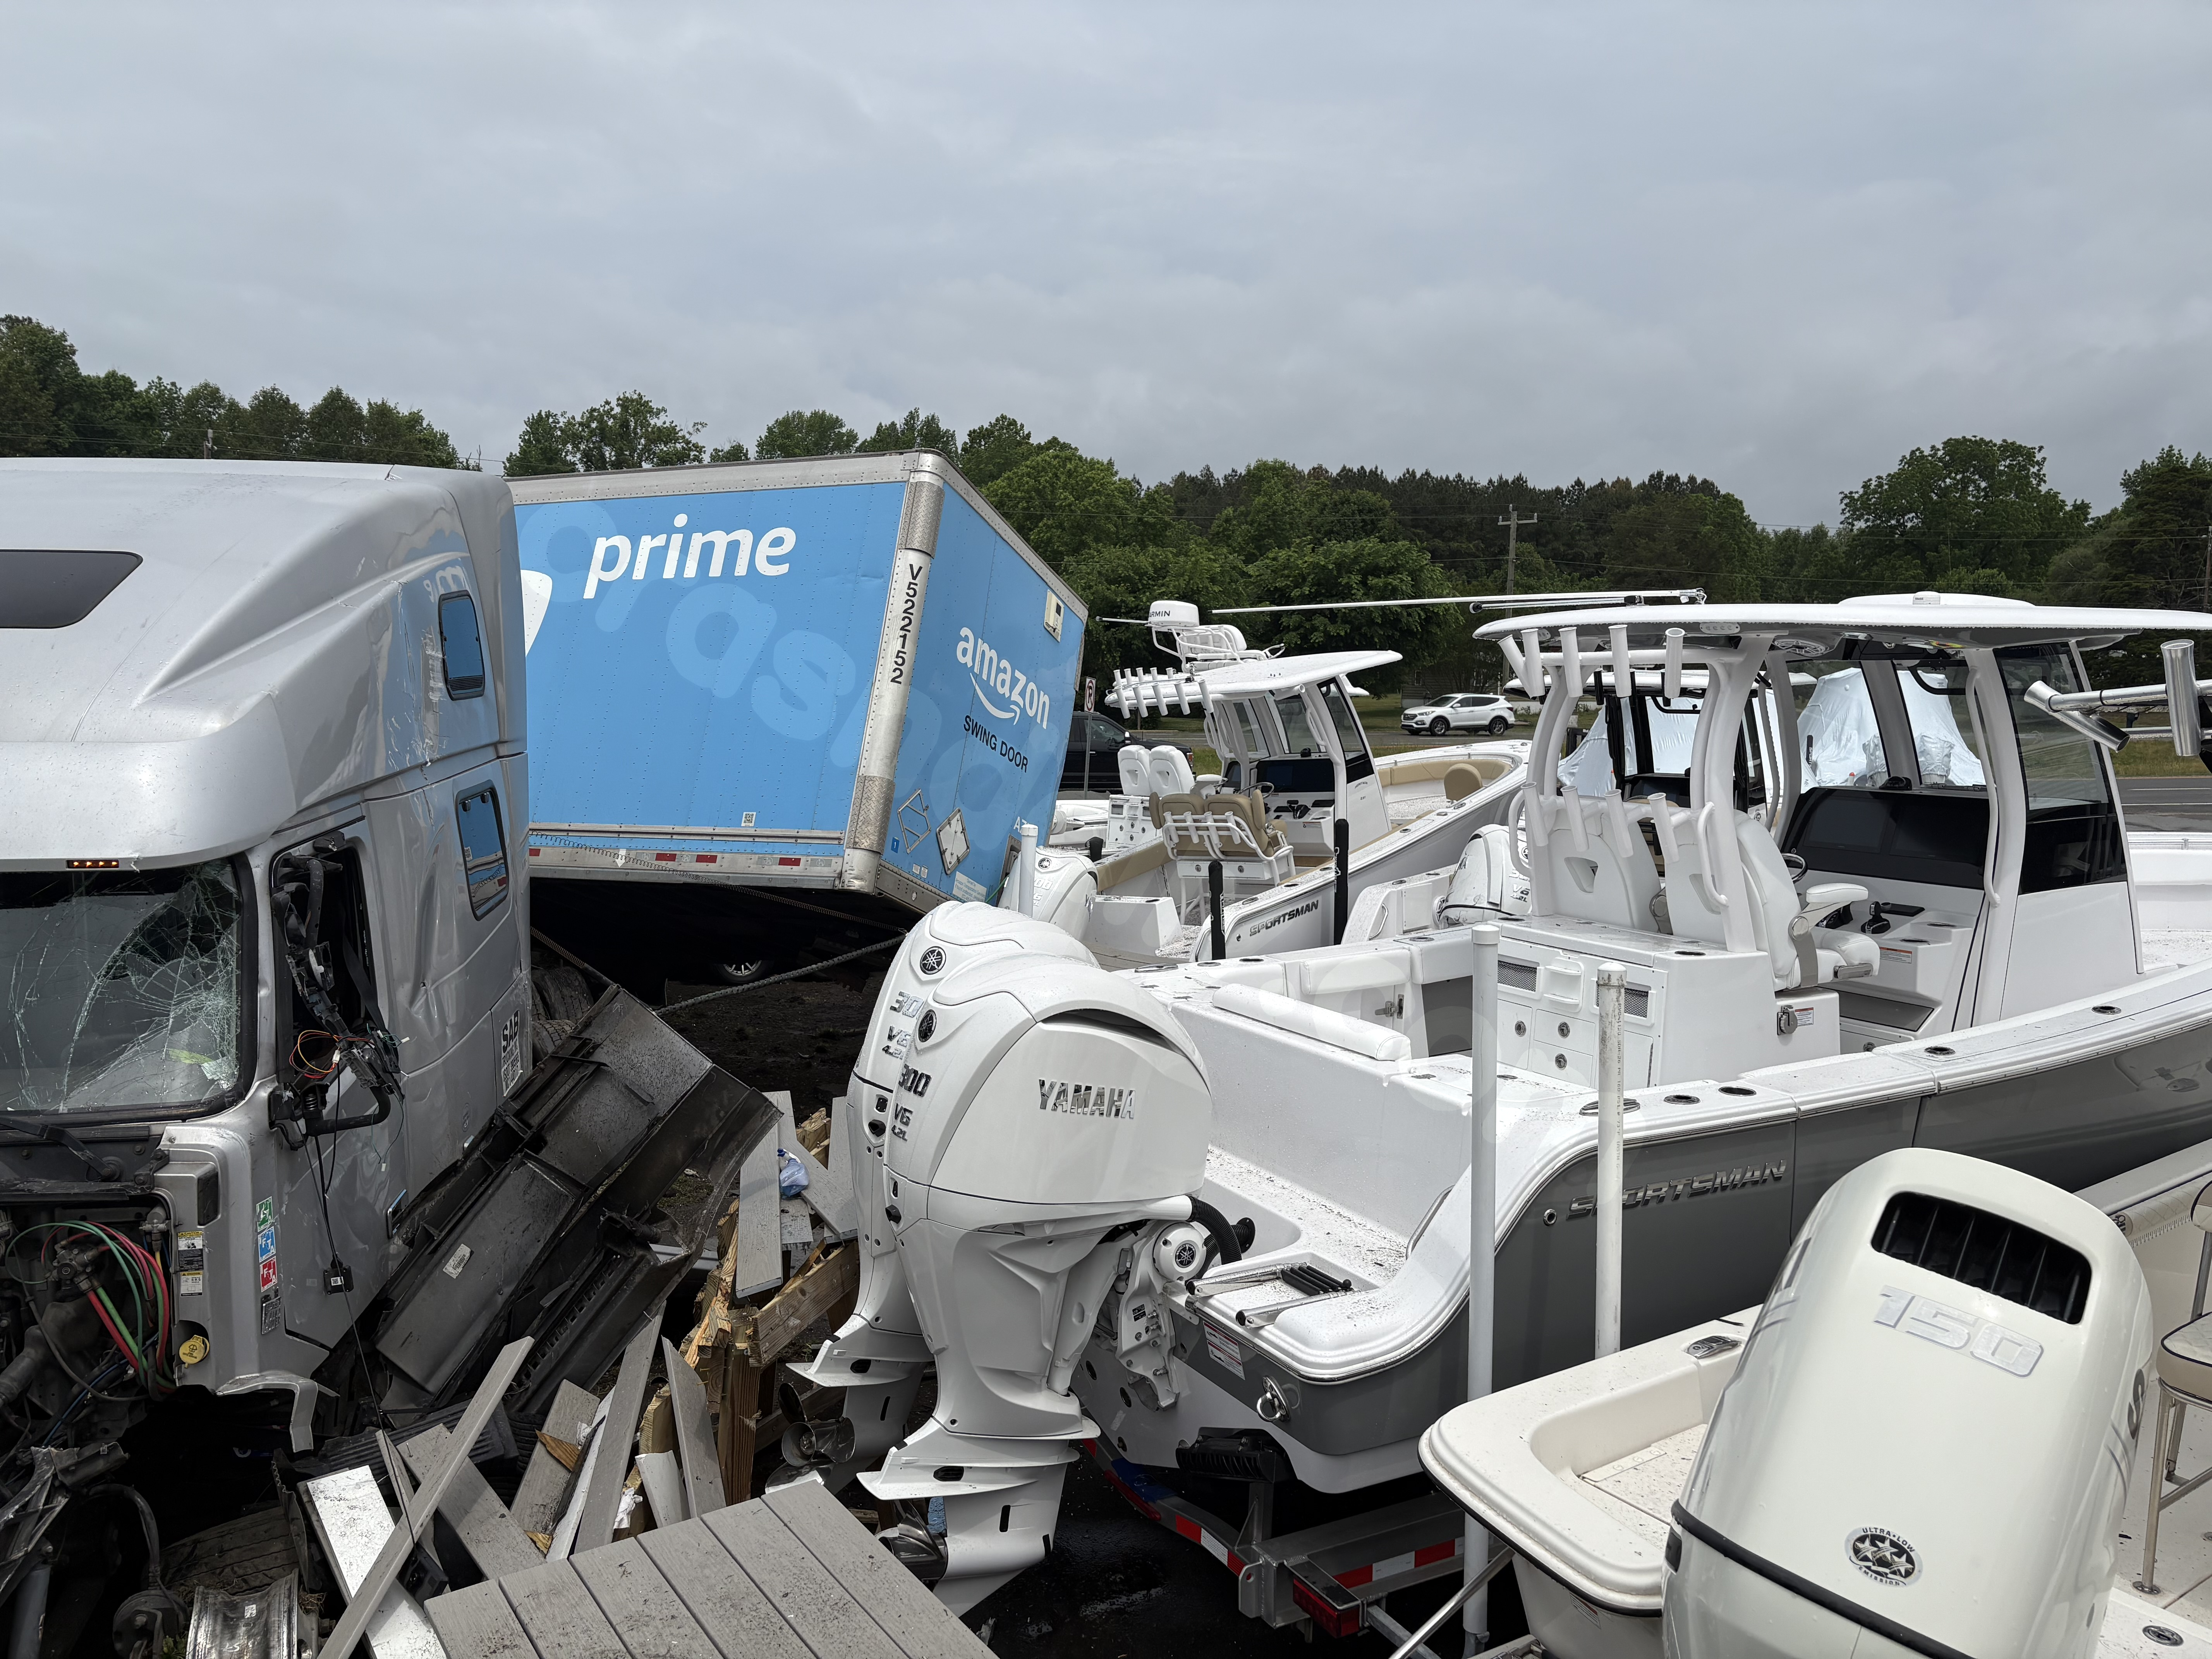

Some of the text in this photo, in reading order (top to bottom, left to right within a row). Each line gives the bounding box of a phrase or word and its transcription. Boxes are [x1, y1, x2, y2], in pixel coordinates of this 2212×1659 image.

[583, 514, 796, 599] prime
[890, 563, 923, 685] V522152
[956, 627, 1050, 730] amazon
[963, 714, 1029, 774] SWING DOOR
[1034, 878, 1053, 890] 00
[1510, 893, 1527, 903] 4.2L
[1249, 900, 1319, 936] SPORTSMAN
[890, 991, 925, 1018] 30
[502, 1010, 519, 1054] SAB
[898, 1063, 932, 1098] 300
[1038, 1079, 1136, 1119] YAMAHA
[895, 1103, 914, 1126] V6
[1566, 1159, 1787, 1220] SORTSMAN
[1872, 1285, 2044, 1379] 150
